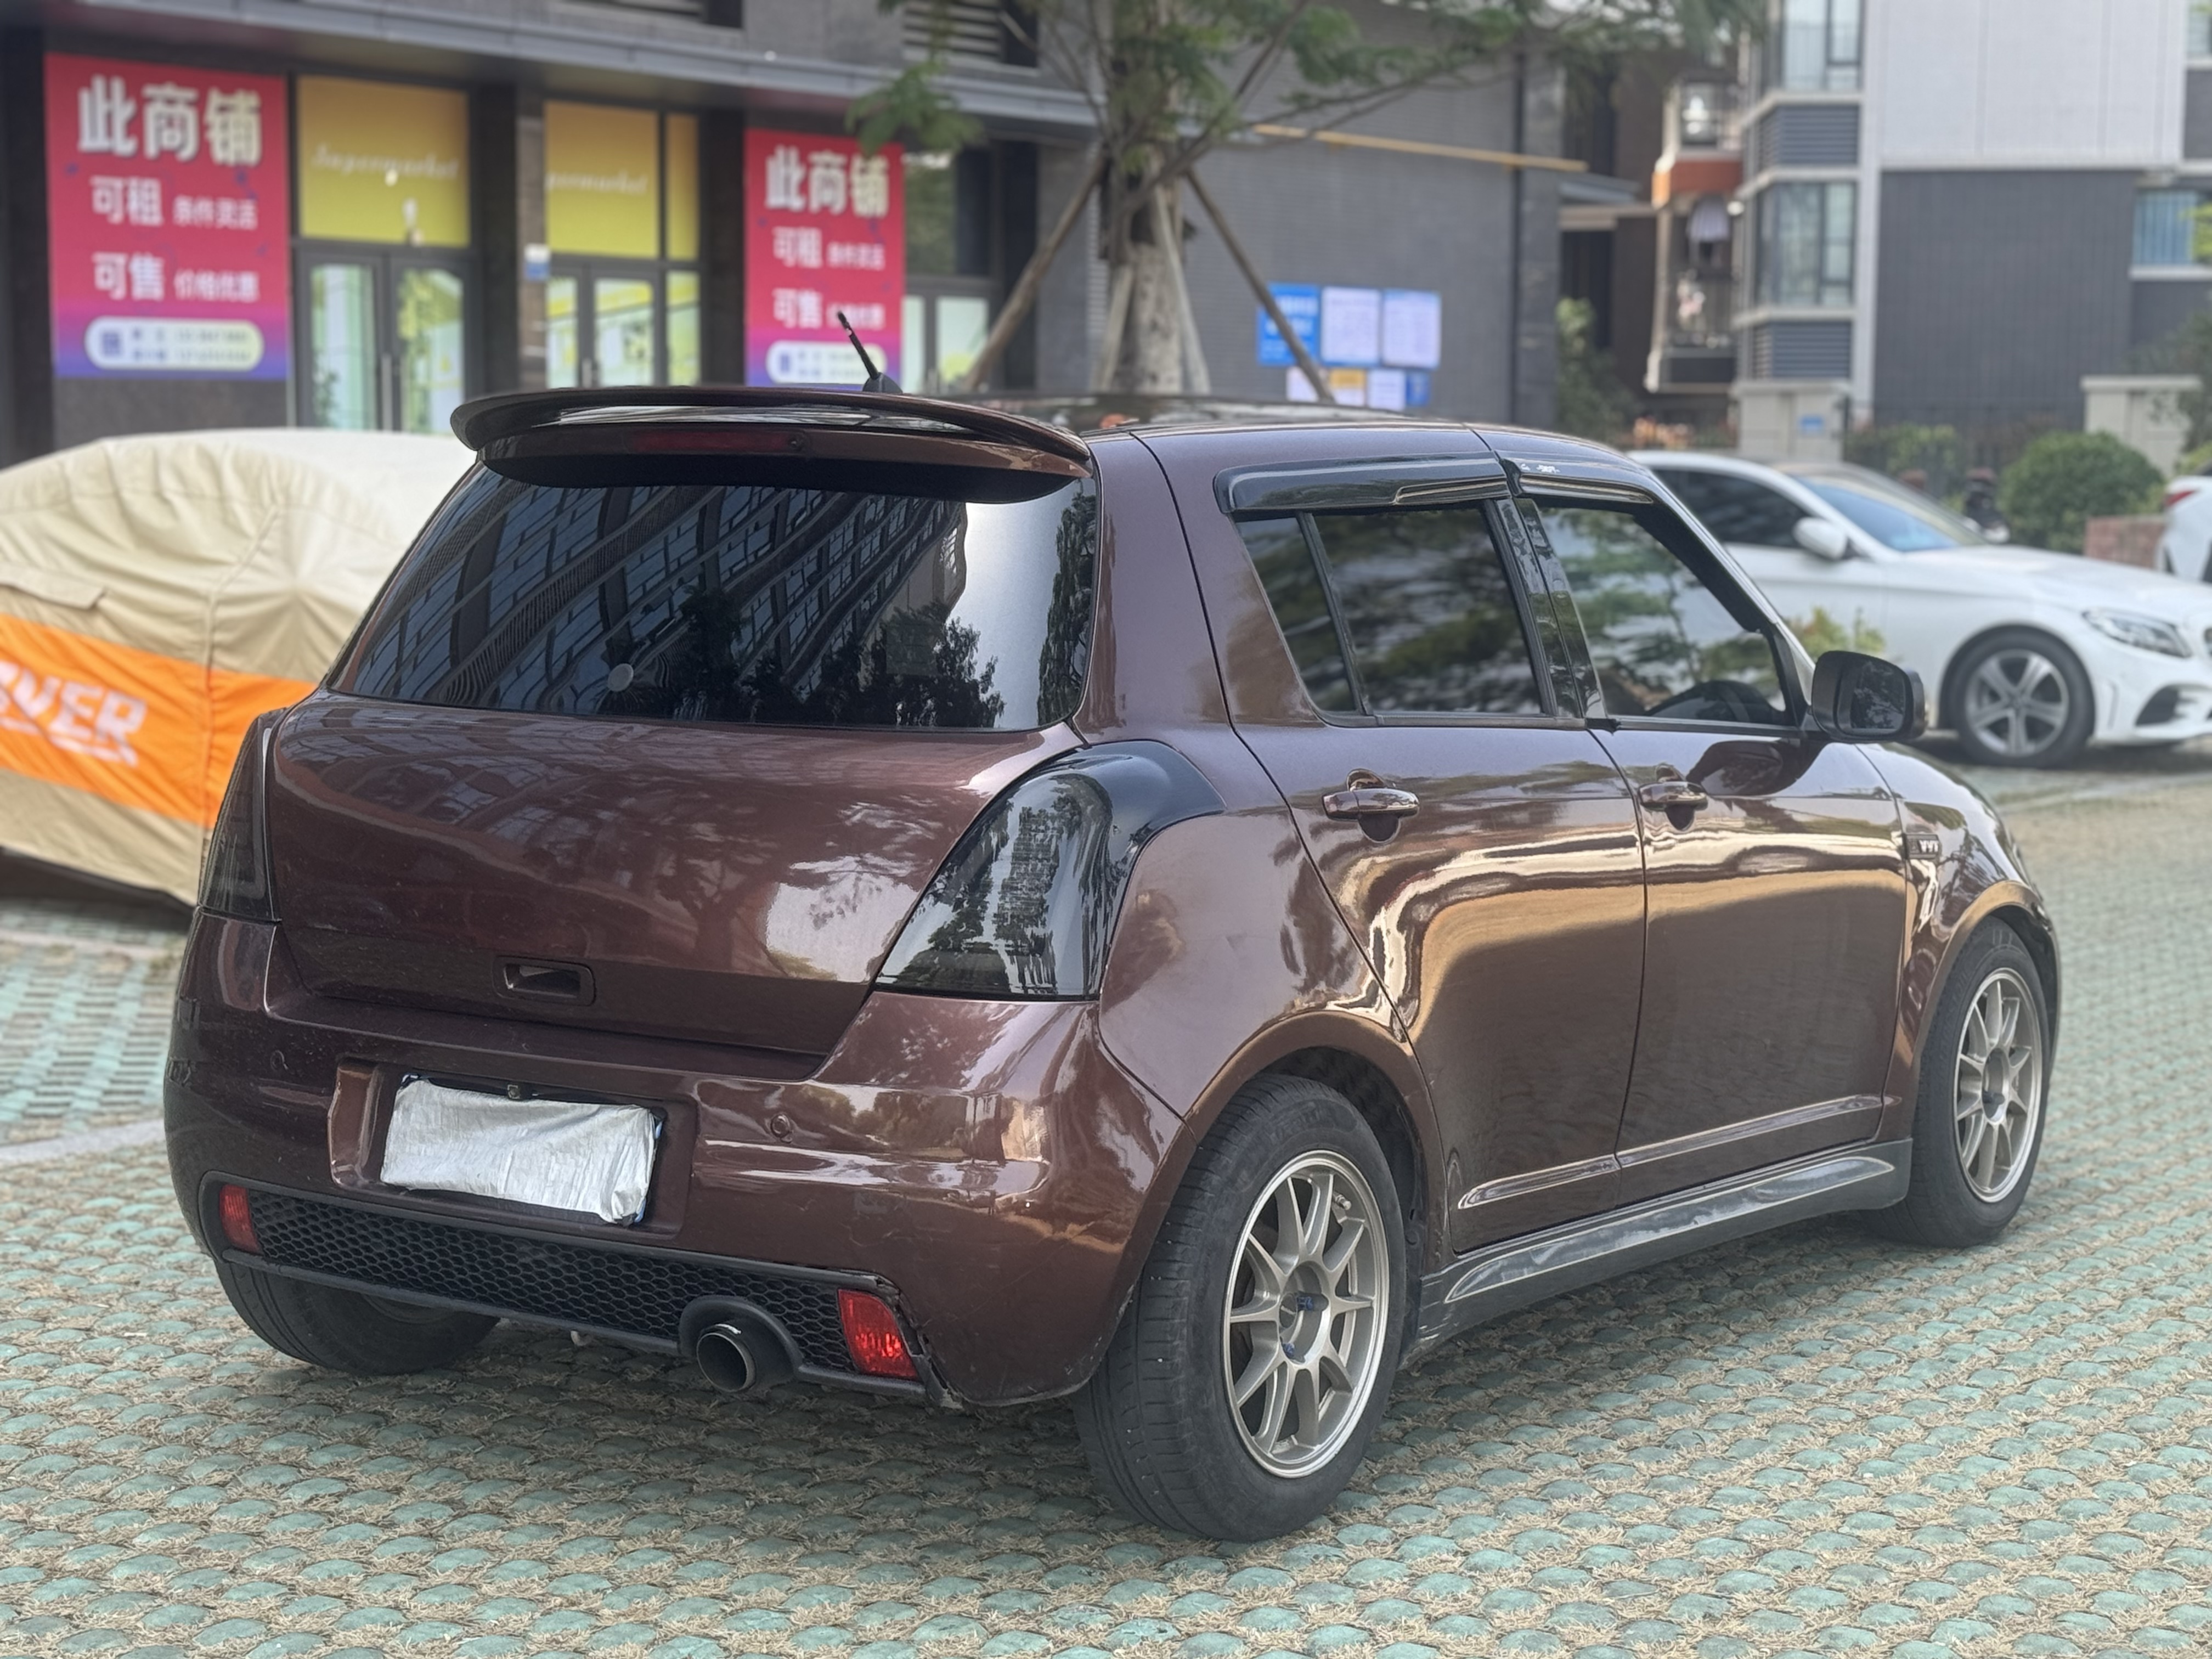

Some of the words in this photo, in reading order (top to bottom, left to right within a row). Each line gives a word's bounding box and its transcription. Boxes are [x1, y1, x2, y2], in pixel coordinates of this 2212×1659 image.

[77, 74, 261, 167] 此商铺
[89, 175, 163, 227] 可租
[765, 145, 890, 219] 此商铺
[772, 226, 822, 269] 可租
[92, 251, 164, 301] 可售
[772, 287, 822, 329] 可售
